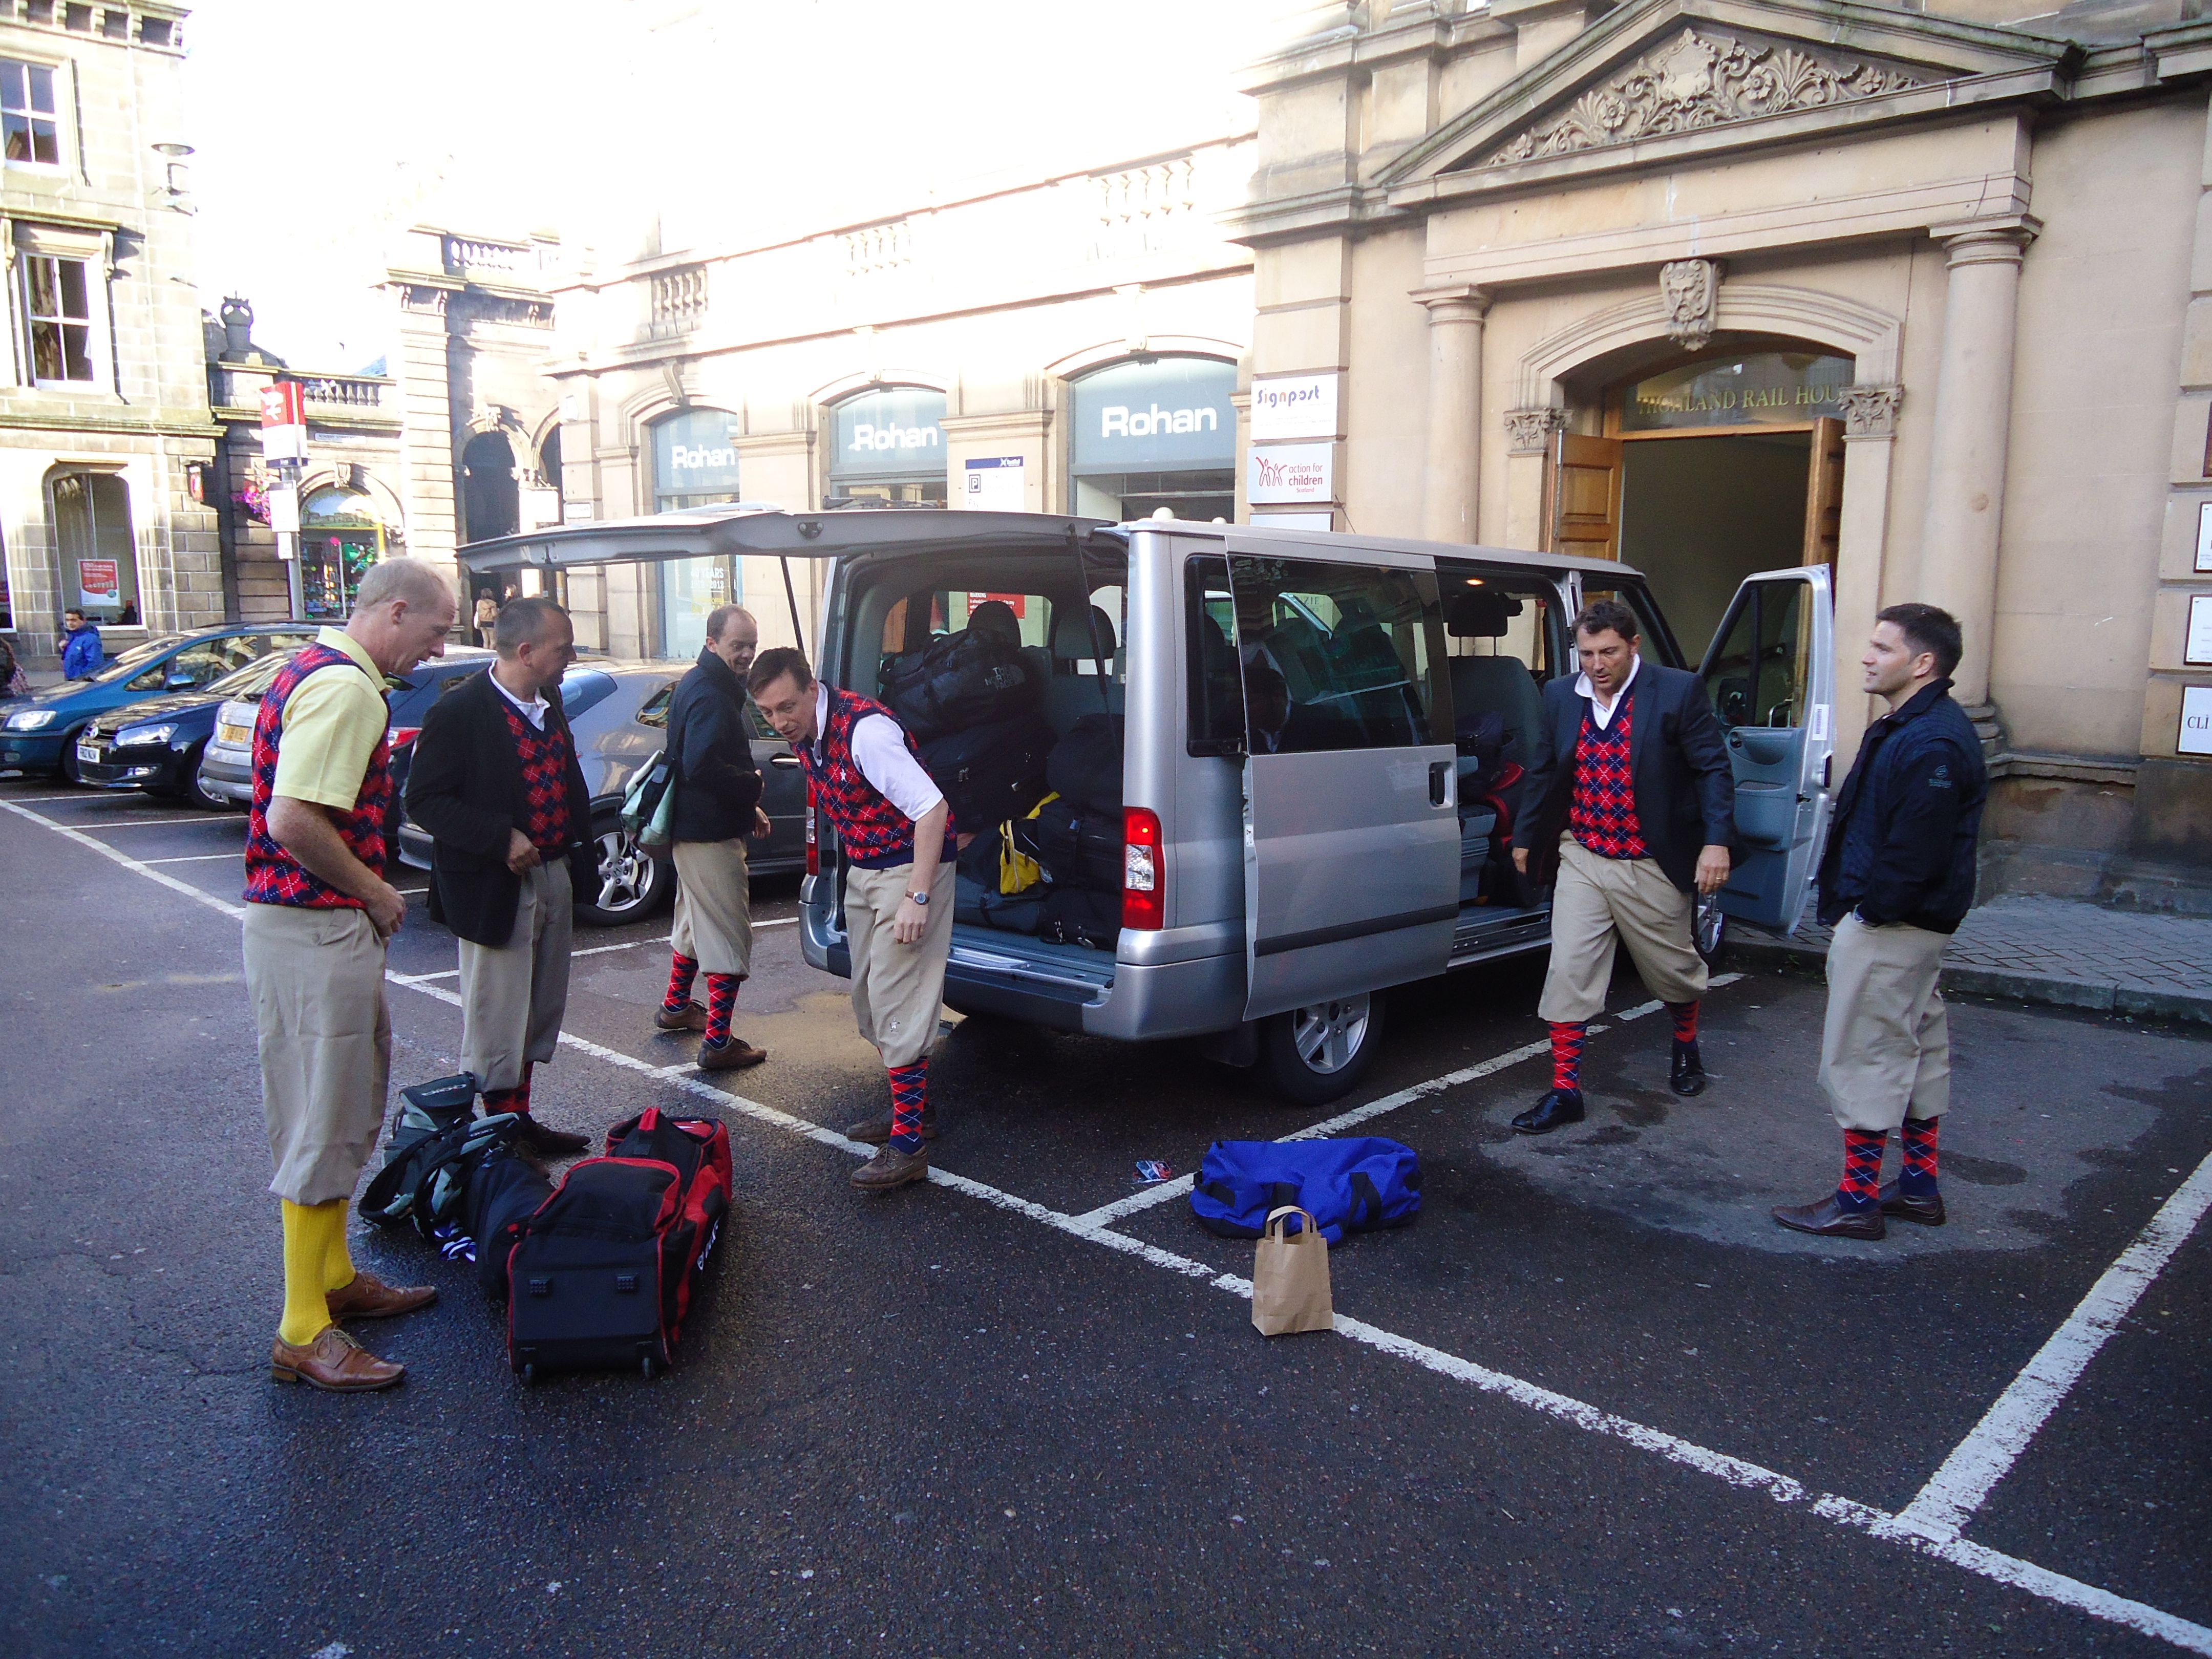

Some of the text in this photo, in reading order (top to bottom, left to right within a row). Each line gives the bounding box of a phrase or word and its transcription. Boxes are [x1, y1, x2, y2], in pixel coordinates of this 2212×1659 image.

[1258, 385, 1319, 408] Signpost
[1742, 387, 1788, 408] RAIL
[1794, 384, 1842, 406] HOU
[1102, 403, 1217, 438] Rohan
[855, 422, 938, 451] Rohan
[671, 444, 735, 469] Rohan
[1289, 462, 1323, 474] action for
[1288, 475, 1323, 486] children
